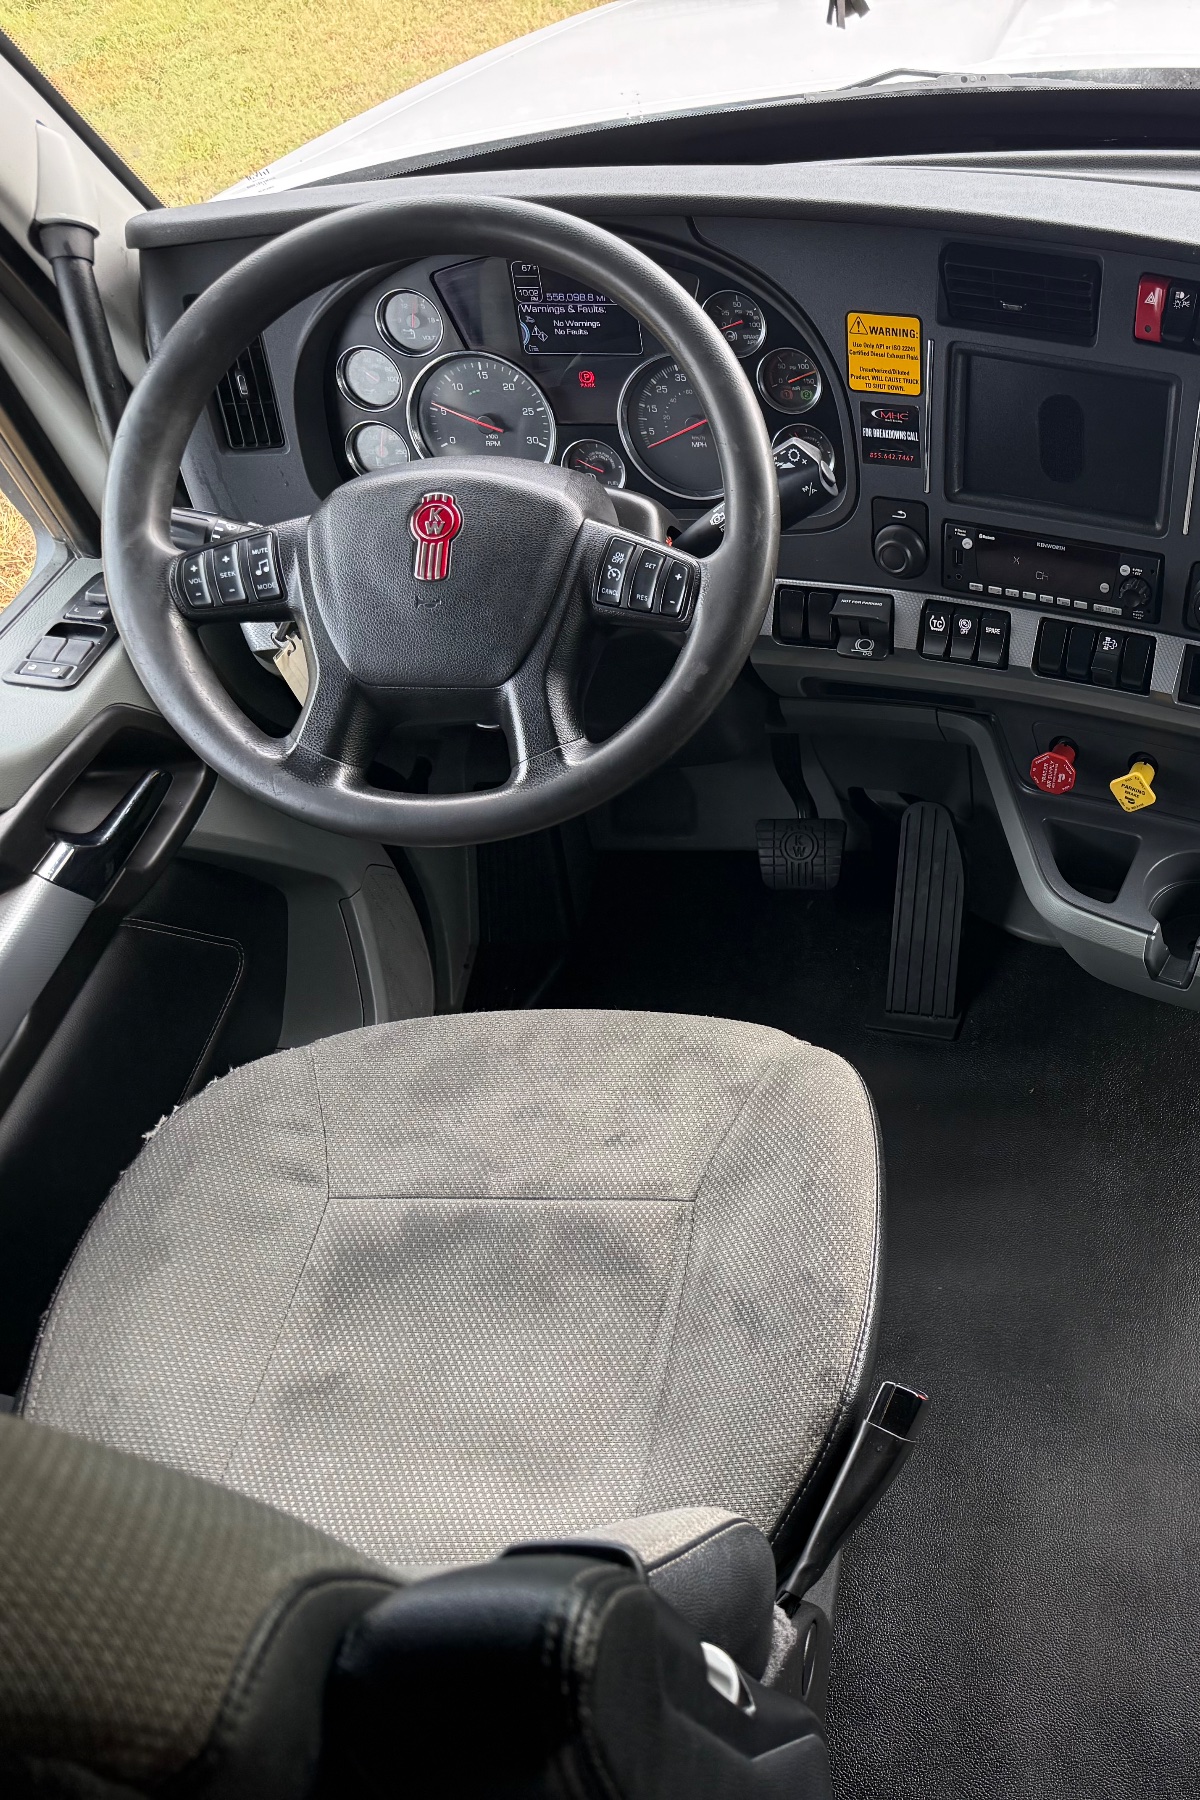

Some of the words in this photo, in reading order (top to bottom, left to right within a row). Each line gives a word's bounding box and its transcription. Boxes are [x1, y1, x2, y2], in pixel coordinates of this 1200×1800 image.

[521, 305, 566, 314] Warnings
[567, 305, 575, 313] &
[566, 320, 601, 328] Warnings
[869, 326, 919, 339] WARNING:
[476, 371, 489, 380] 15
[674, 373, 687, 382] 35
[451, 382, 464, 391] 10
[502, 382, 515, 391] 20
[655, 385, 668, 394] 25
[440, 408, 447, 416] 5
[522, 407, 535, 416] 25
[646, 404, 658, 413] 15
[880, 410, 909, 420] MHC
[648, 427, 655, 436] 5
[862, 427, 873, 438] FOR
[872, 428, 907, 440] BREAKDOWNS
[906, 431, 920, 442] CALL
[449, 436, 456, 444] 0
[526, 436, 539, 444] 30
[429, 507, 444, 521] K
[425, 520, 446, 535] W
[1036, 541, 1066, 551] KENWORTH
[251, 547, 269, 555] MUTE
[219, 571, 237, 579] SEEK
[636, 593, 648, 602] RES
[985, 626, 1001, 635] SPARE
[1120, 783, 1146, 796] PARKING
